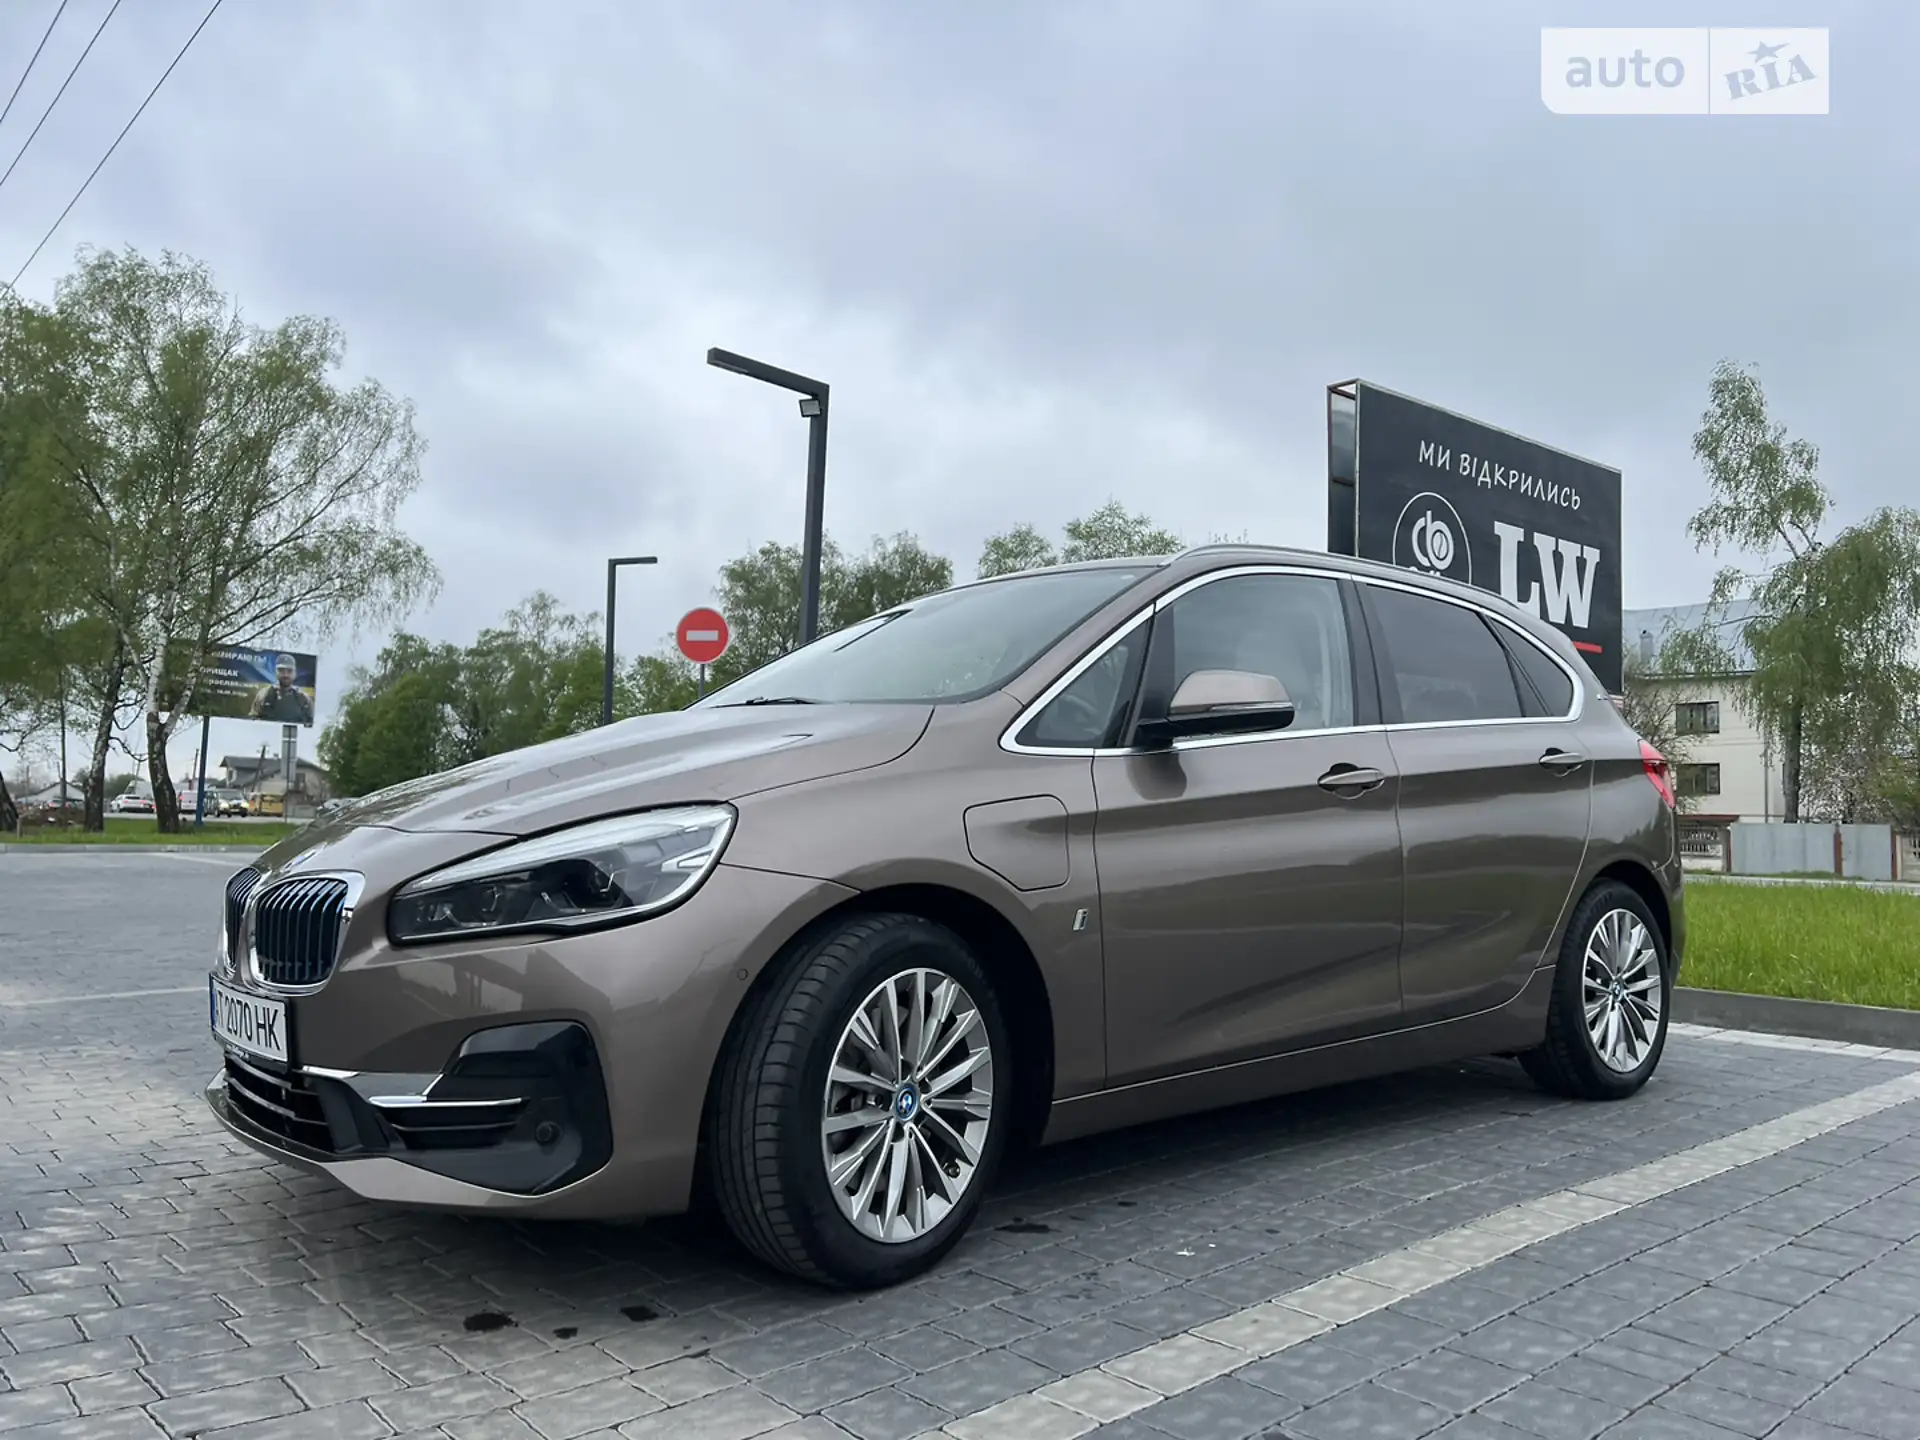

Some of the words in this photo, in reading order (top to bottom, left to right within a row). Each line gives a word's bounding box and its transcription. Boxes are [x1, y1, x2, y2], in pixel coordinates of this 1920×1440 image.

[1419, 439, 1450, 471] МИ
[1459, 453, 1581, 511] ВІДКРИЛИСЬ
[1494, 520, 1600, 628] LW
[225, 995, 252, 1041] 2070
[254, 1004, 281, 1051] HK
